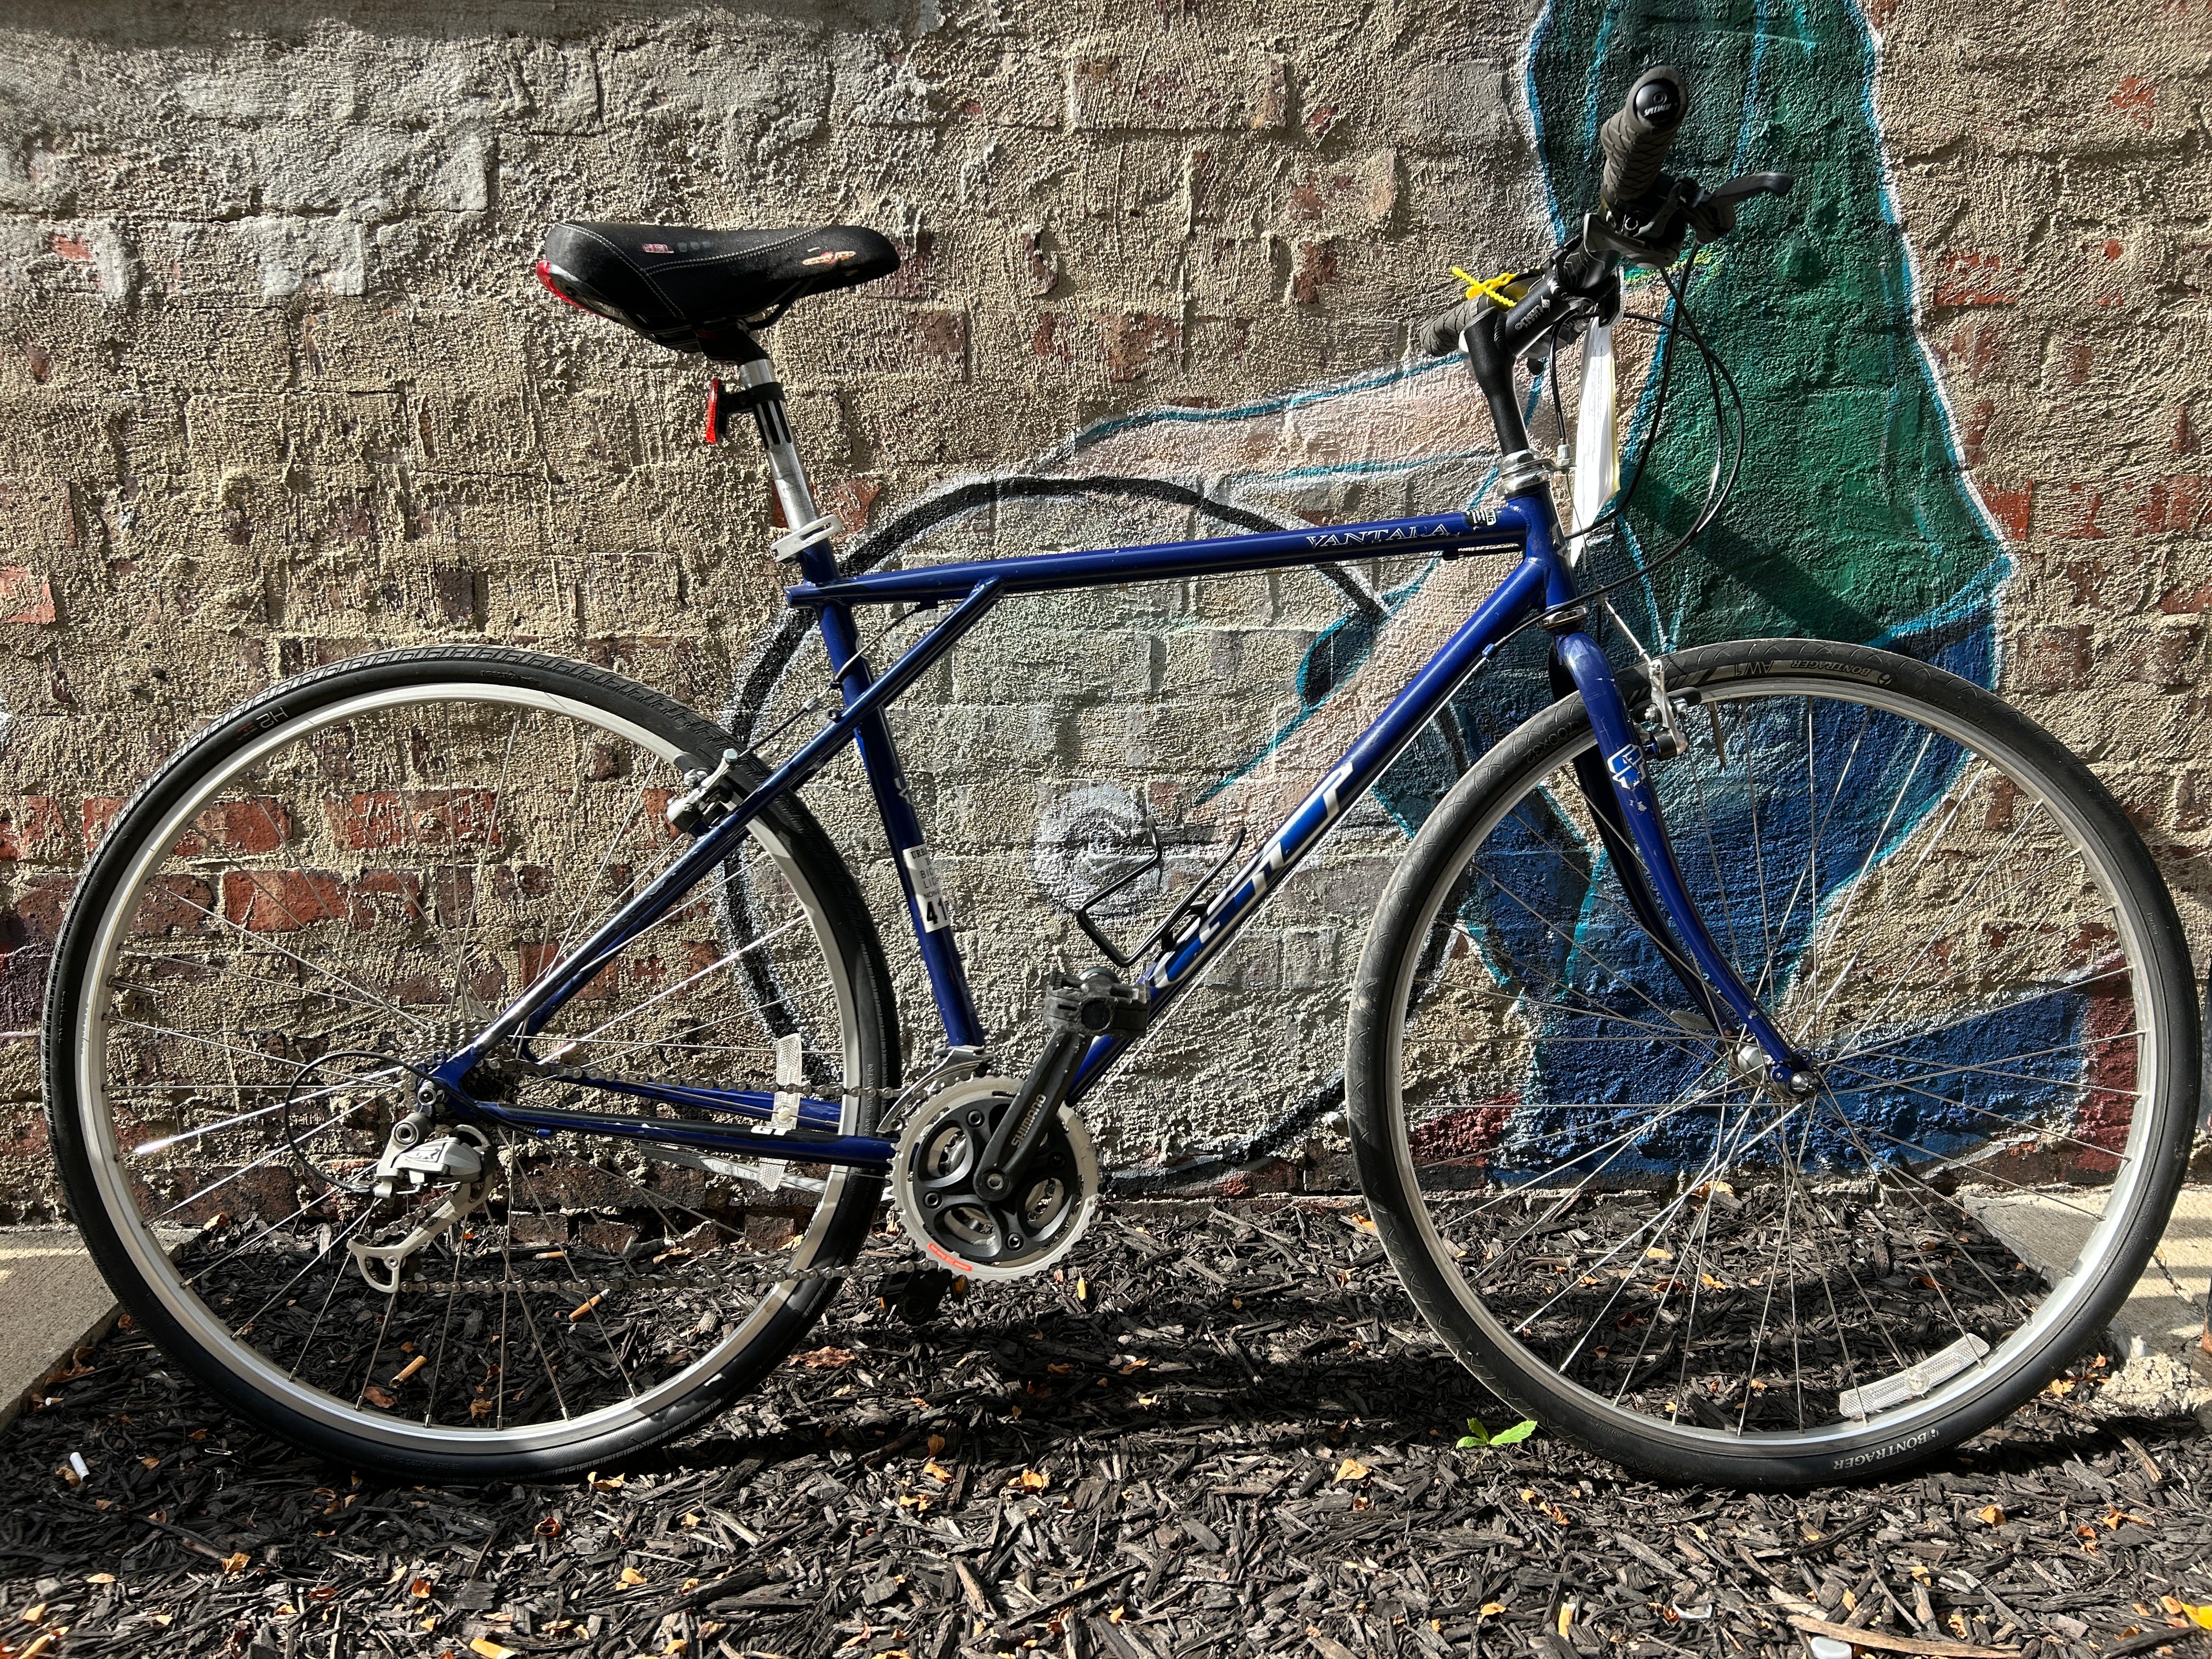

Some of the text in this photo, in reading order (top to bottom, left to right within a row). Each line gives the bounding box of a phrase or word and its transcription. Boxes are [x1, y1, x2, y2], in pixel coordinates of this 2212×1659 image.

[1790, 659, 1872, 677] BONTRAGER
[255, 704, 289, 729] H2
[1010, 1094, 1047, 1148] SHIMANO
[1833, 1431, 1928, 1470] BONTRAGER
